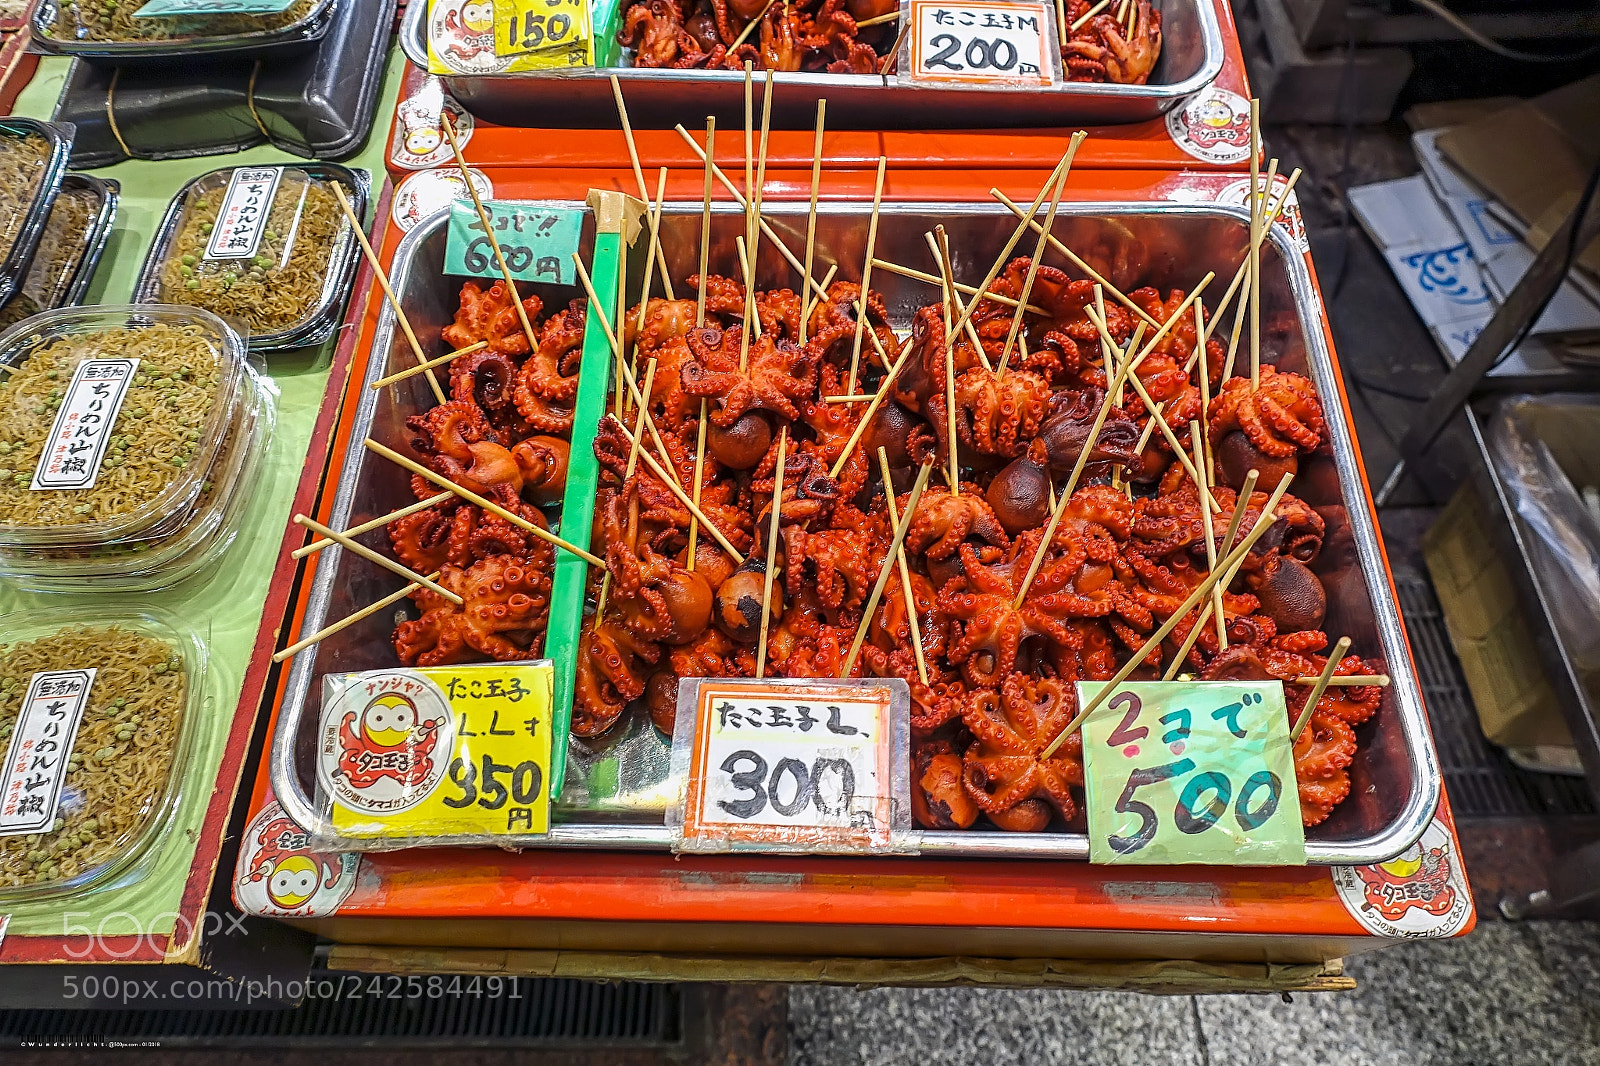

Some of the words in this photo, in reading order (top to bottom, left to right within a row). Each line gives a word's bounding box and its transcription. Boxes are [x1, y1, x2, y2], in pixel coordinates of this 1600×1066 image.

[509, 9, 571, 48] 150
[227, 183, 263, 250] ちりめん山椒
[60, 382, 111, 475] ちりめん山椒
[446, 675, 532, 704] たこ玉子
[1106, 689, 1262, 748] 2コで
[17, 700, 67, 816] ちりめん山椒
[507, 807, 533, 831] 円
[1106, 757, 1283, 856] 500
